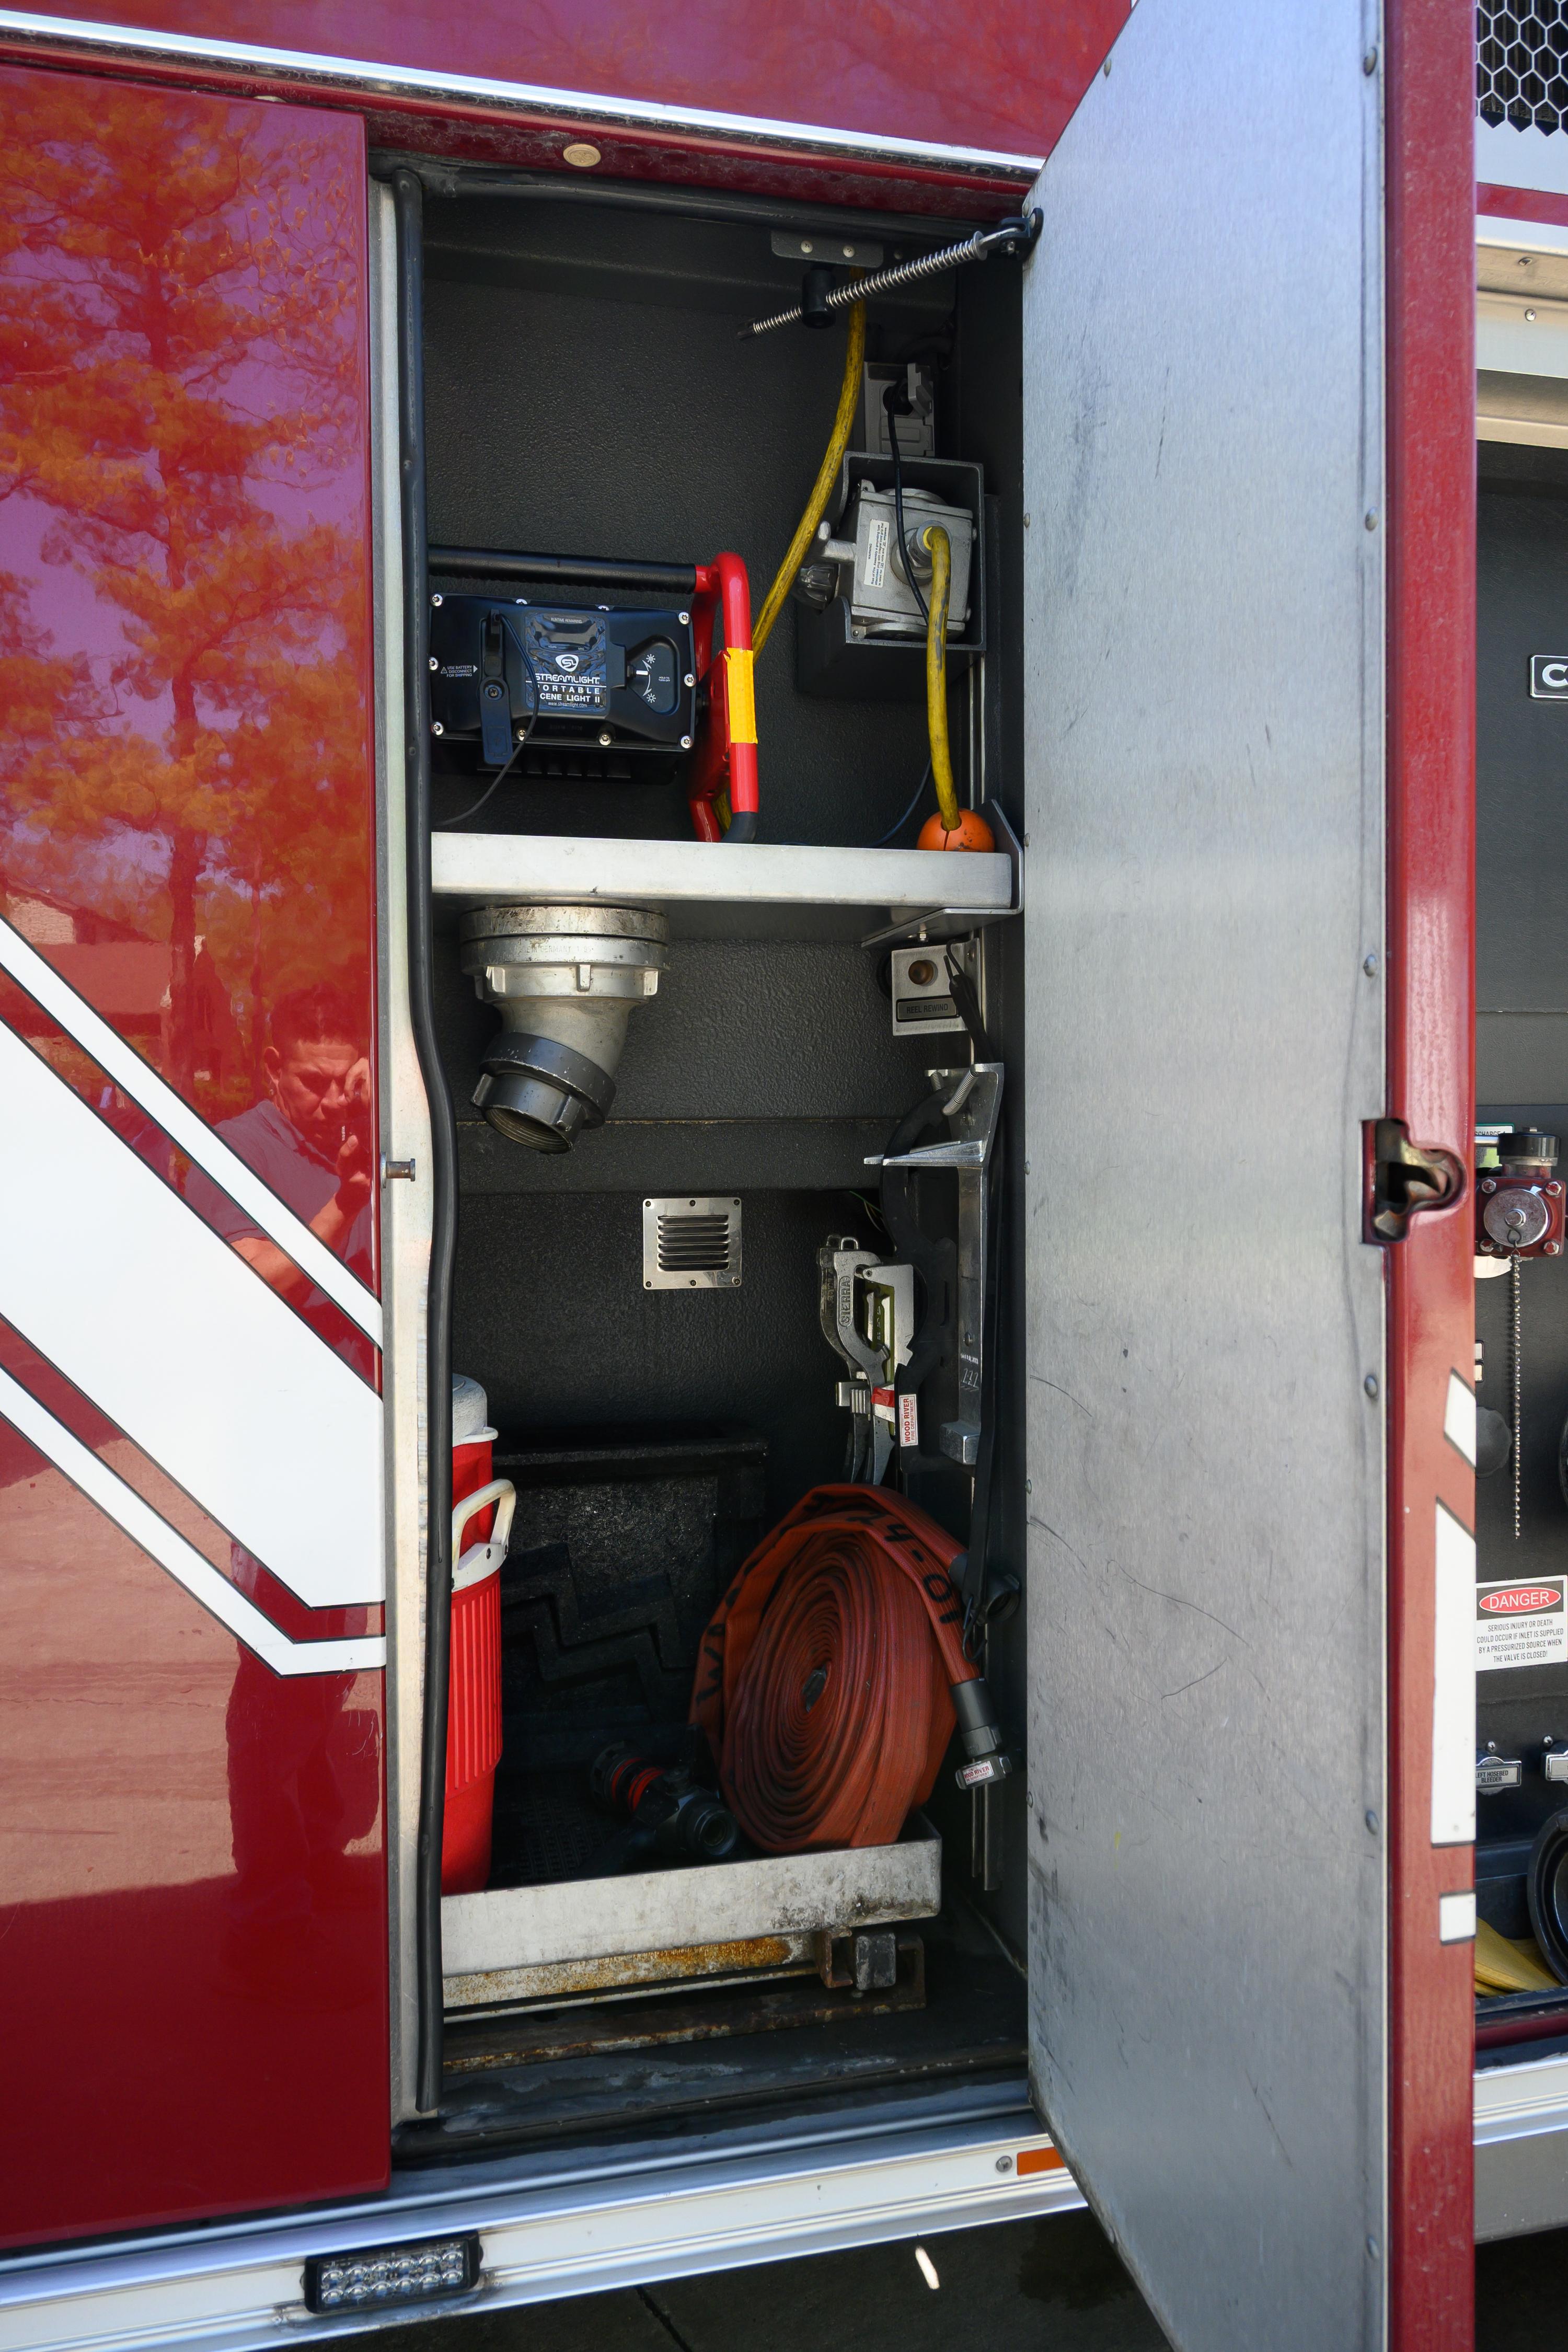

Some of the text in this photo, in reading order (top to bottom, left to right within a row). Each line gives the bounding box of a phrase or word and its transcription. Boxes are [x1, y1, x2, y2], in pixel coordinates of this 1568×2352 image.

[538, 684, 600, 695] ORTABLE
[924, 1004, 948, 1012] REWIND
[841, 1280, 850, 1323] SIERRA
[1490, 1592, 1550, 1609] DANGER
[1488, 1623, 1509, 1632] SERIOUS
[1511, 1621, 1528, 1630] INJURY
[1477, 1635, 1494, 1644] COULD
[1495, 1633, 1512, 1642] OCCUR
[1540, 1628, 1564, 1637] SUPPLIED
[1491, 1643, 1525, 1652] PRESSURIZED
[1504, 1653, 1520, 1662] VALVE
[1527, 1651, 1548, 1659] CLOSED!
[970, 1771, 989, 1780] DEPARTMENT
[974, 1766, 989, 1775] RIVER
